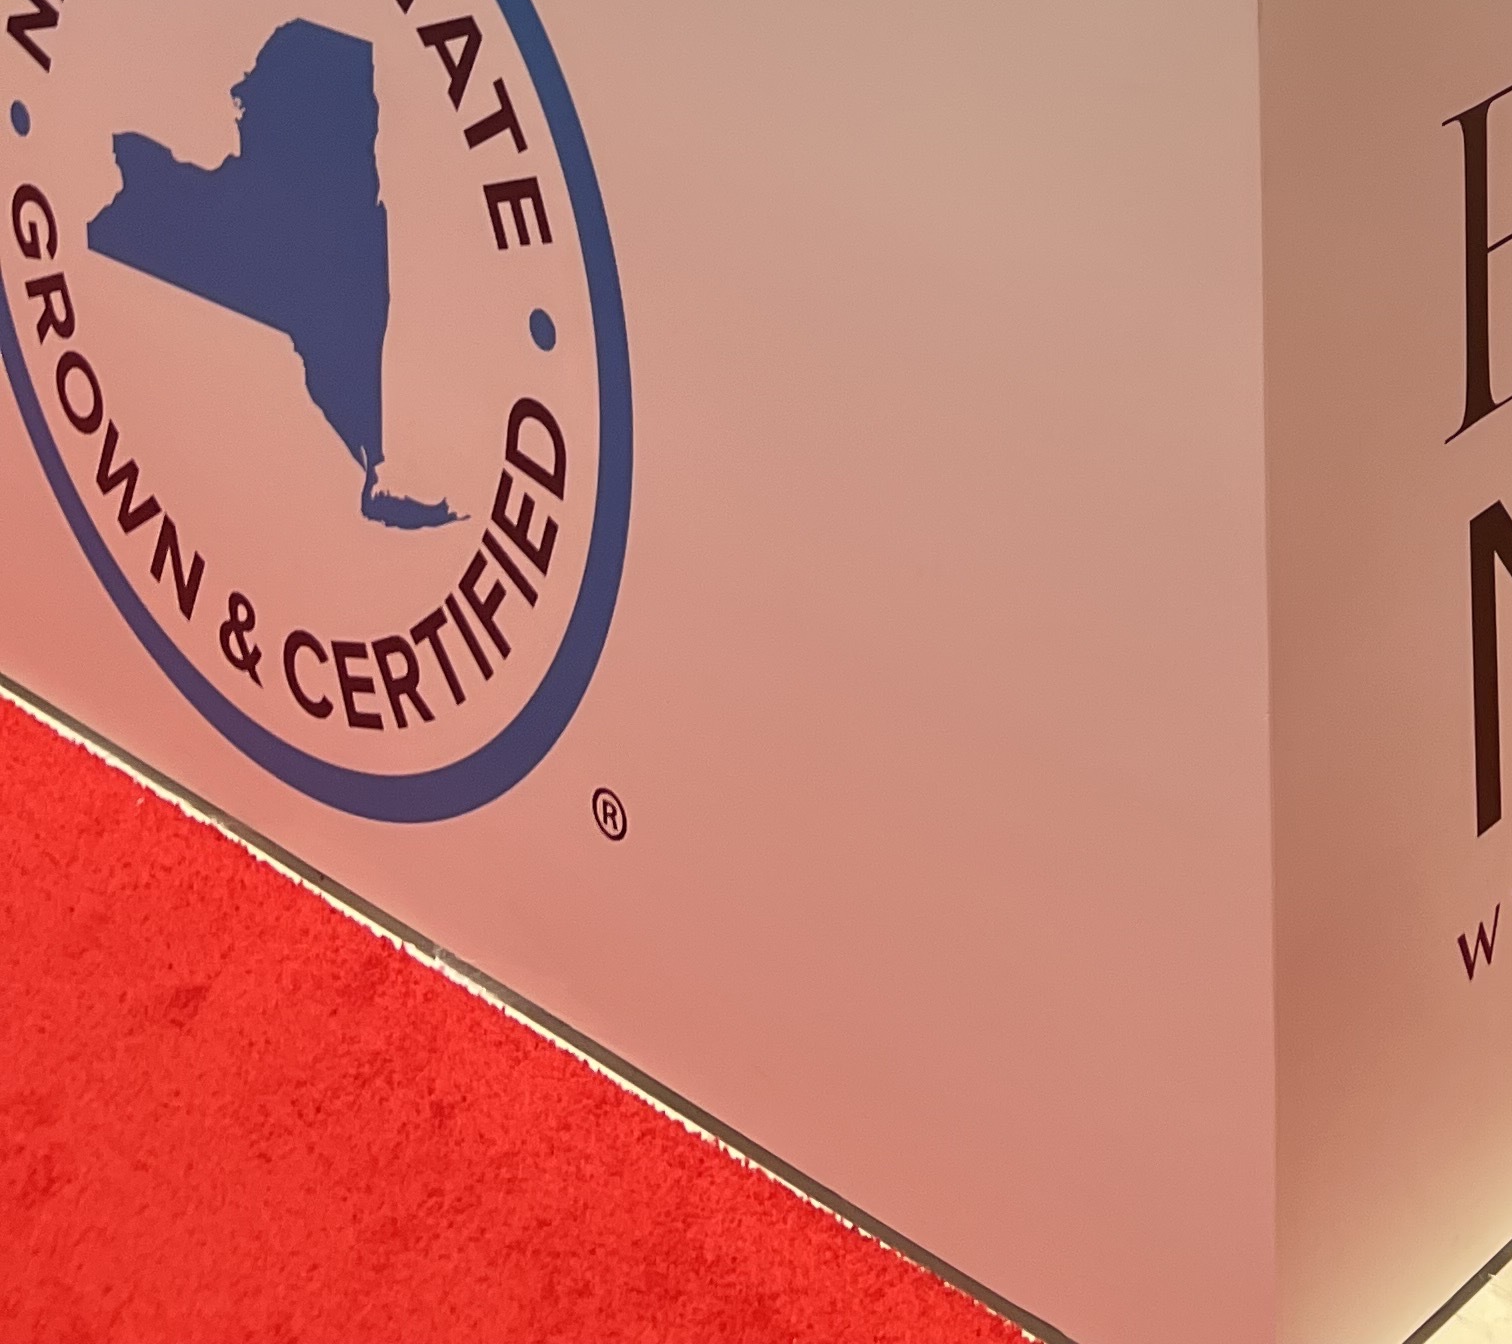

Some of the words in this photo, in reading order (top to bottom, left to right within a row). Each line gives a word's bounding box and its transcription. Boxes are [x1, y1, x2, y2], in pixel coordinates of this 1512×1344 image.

[11, 183, 206, 622] GROWN
[219, 591, 264, 689] &
[283, 396, 568, 731] CERTIFIED
